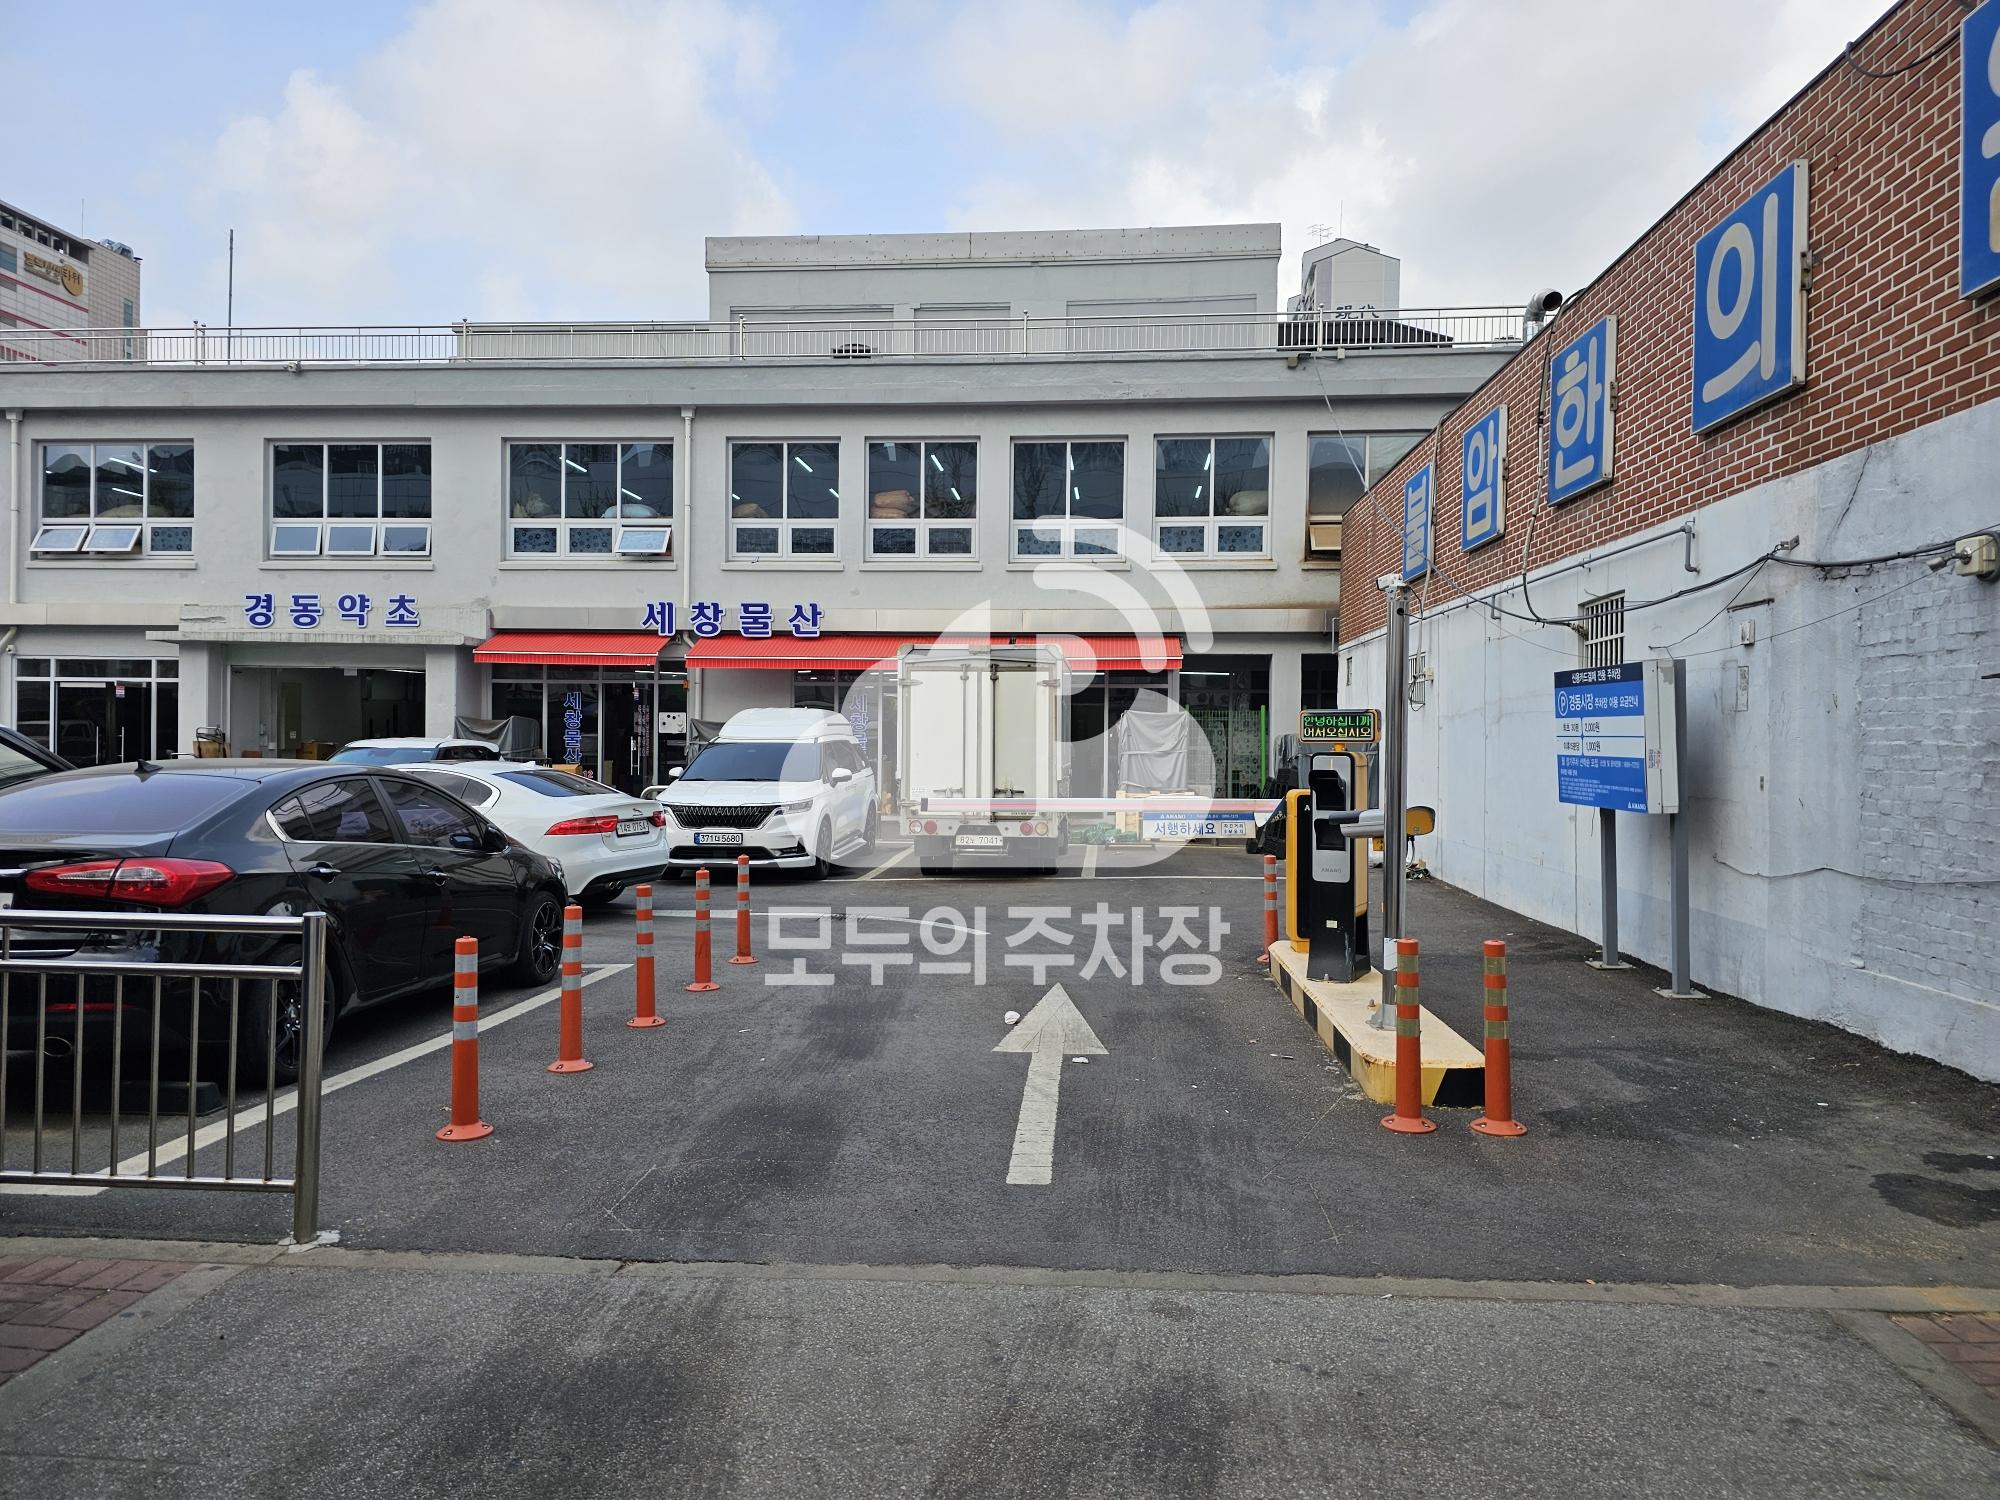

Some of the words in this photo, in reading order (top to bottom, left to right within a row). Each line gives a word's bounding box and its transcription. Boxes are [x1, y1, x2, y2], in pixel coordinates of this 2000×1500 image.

[243, 593, 422, 629] 경동약초
[641, 601, 824, 637] 세창물산
[1607, 667, 1621, 680] 주차장
[1569, 693, 1594, 711] 경동시장
[1594, 697, 1608, 709] 주차장
[1609, 696, 1619, 708] 이용
[563, 691, 583, 765] 세창물산
[850, 695, 869, 759] 세창물
[1303, 715, 1371, 726] 안녕하십니까
[1303, 727, 1372, 737] 어서오십시오
[1154, 821, 1217, 836] 서행하세요
[721, 834, 741, 843] 5680
[978, 836, 998, 845] 7041
